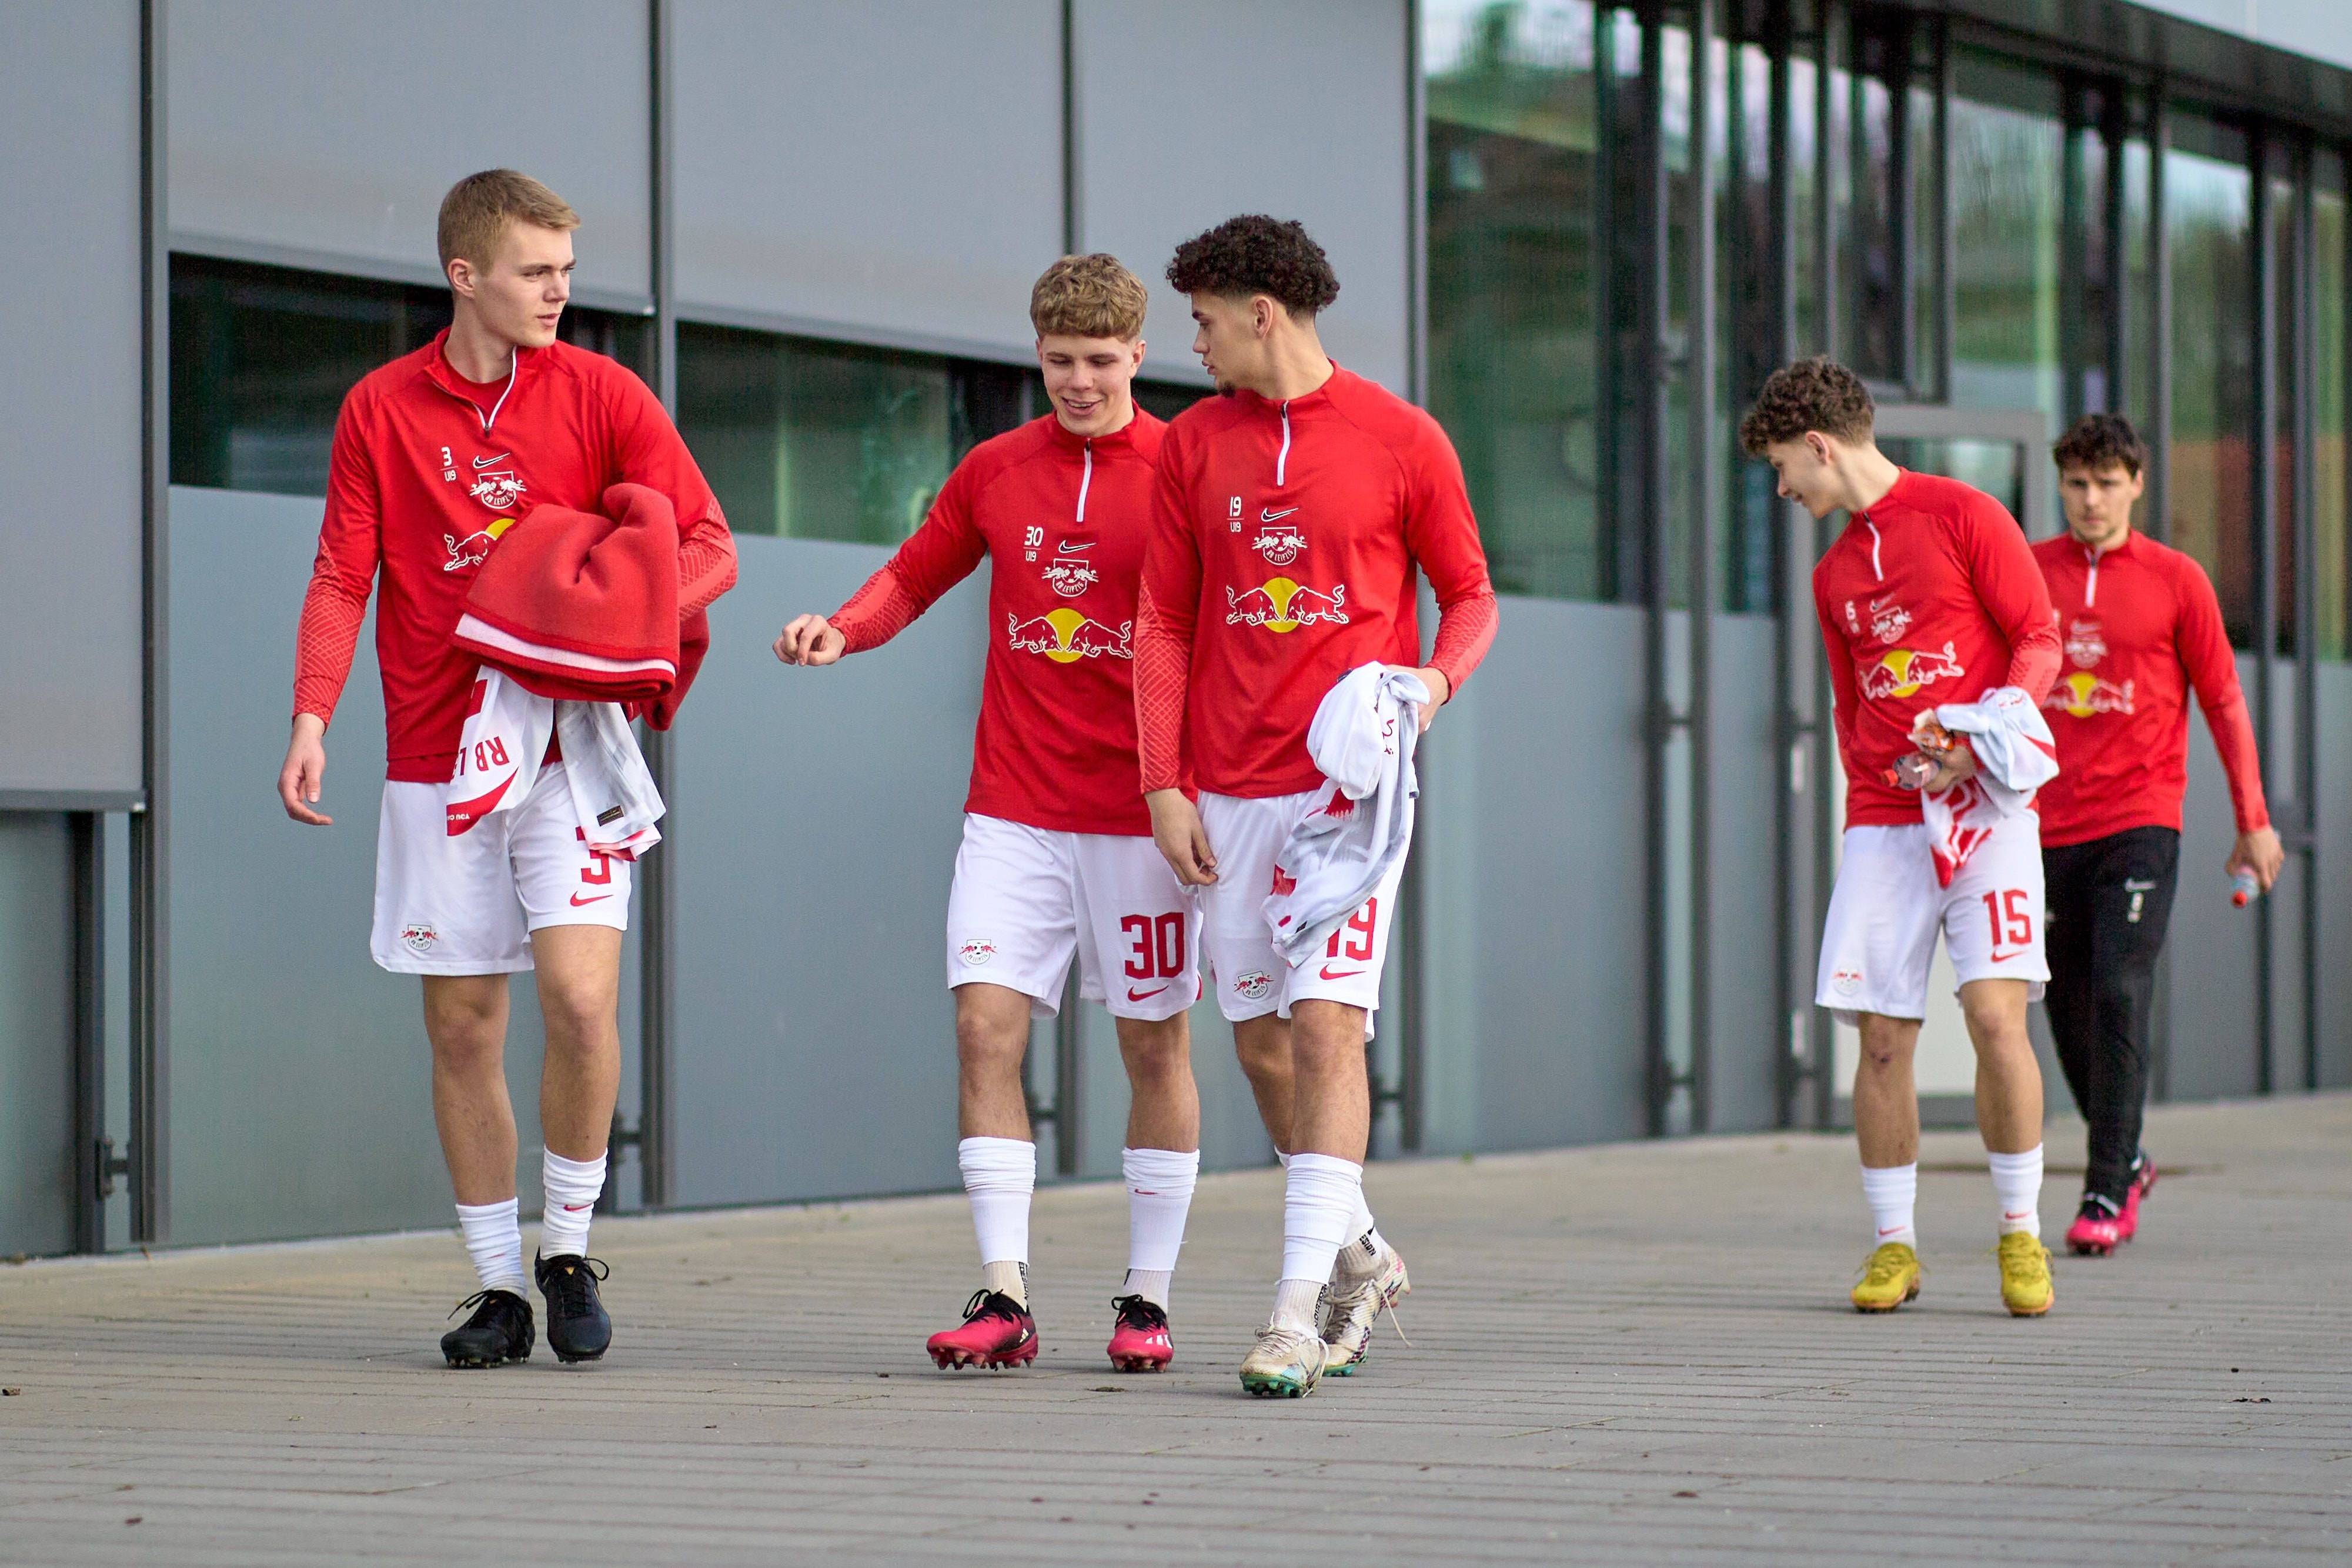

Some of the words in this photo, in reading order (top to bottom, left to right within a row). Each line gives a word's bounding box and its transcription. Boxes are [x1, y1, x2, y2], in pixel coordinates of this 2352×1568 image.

[441, 446, 452, 466] 3
[444, 470, 456, 482] U19
[1229, 496, 1242, 517] 19
[1024, 526, 1044, 547] 30
[1230, 521, 1242, 533] U19
[1025, 550, 1037, 562] U19
[475, 735, 510, 771] RB
[1982, 889, 2032, 947] 15
[1120, 912, 1185, 980] 30
